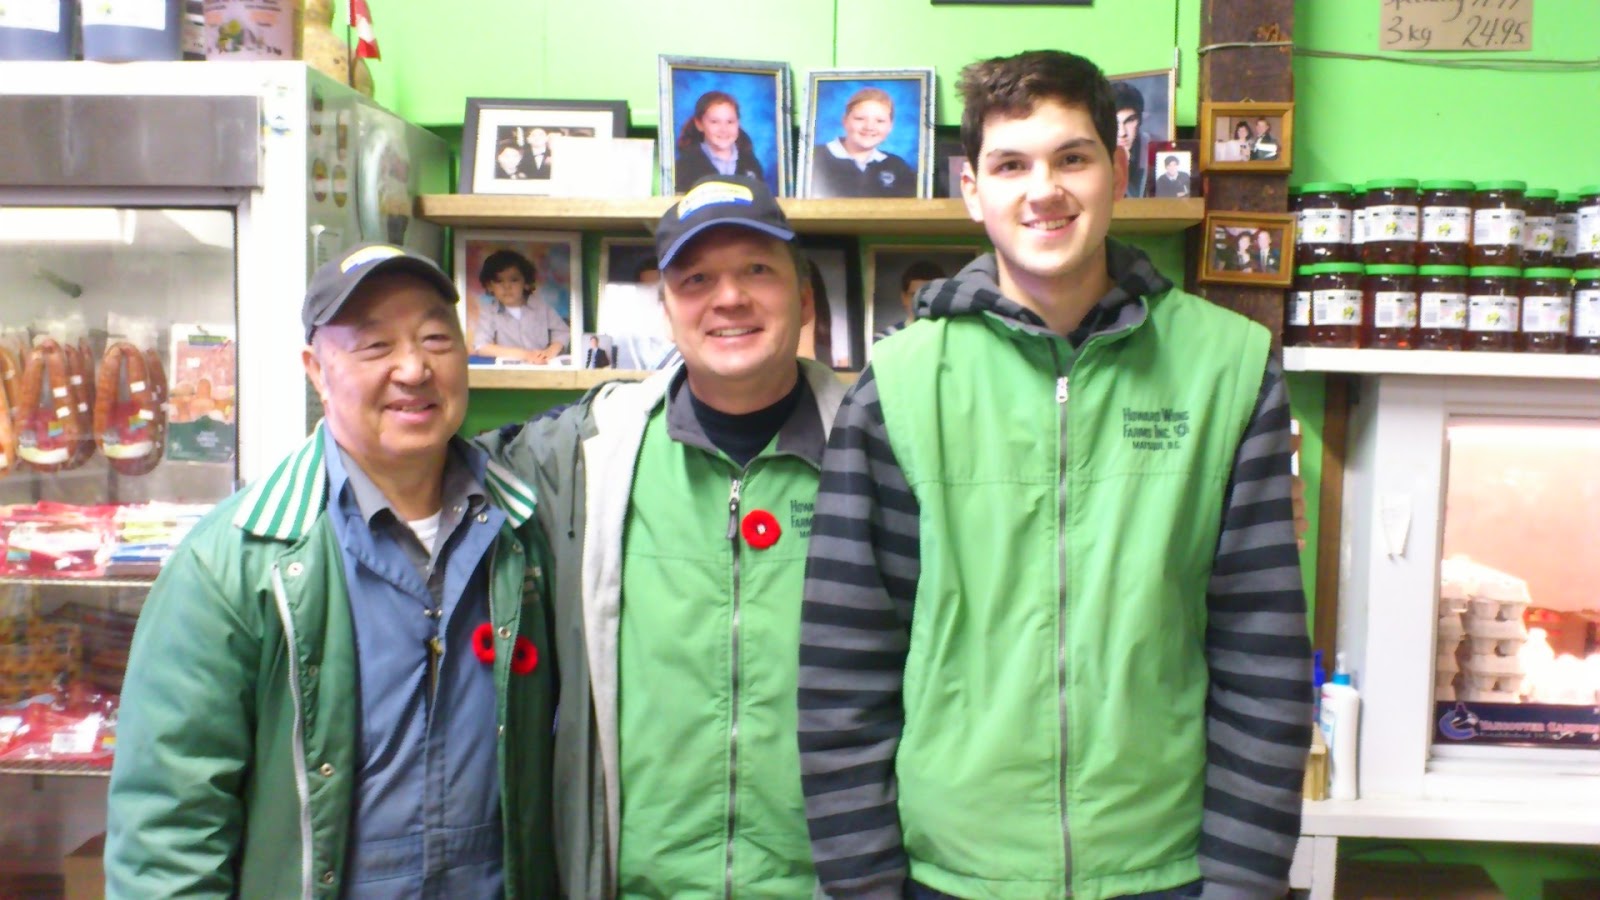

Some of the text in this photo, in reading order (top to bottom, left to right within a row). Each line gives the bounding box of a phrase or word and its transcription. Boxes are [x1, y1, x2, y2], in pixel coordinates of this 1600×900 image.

[1462, 15, 1528, 48] 24.95
[1122, 407, 1161, 421] HOWARD
[1122, 423, 1152, 438] FARMS
